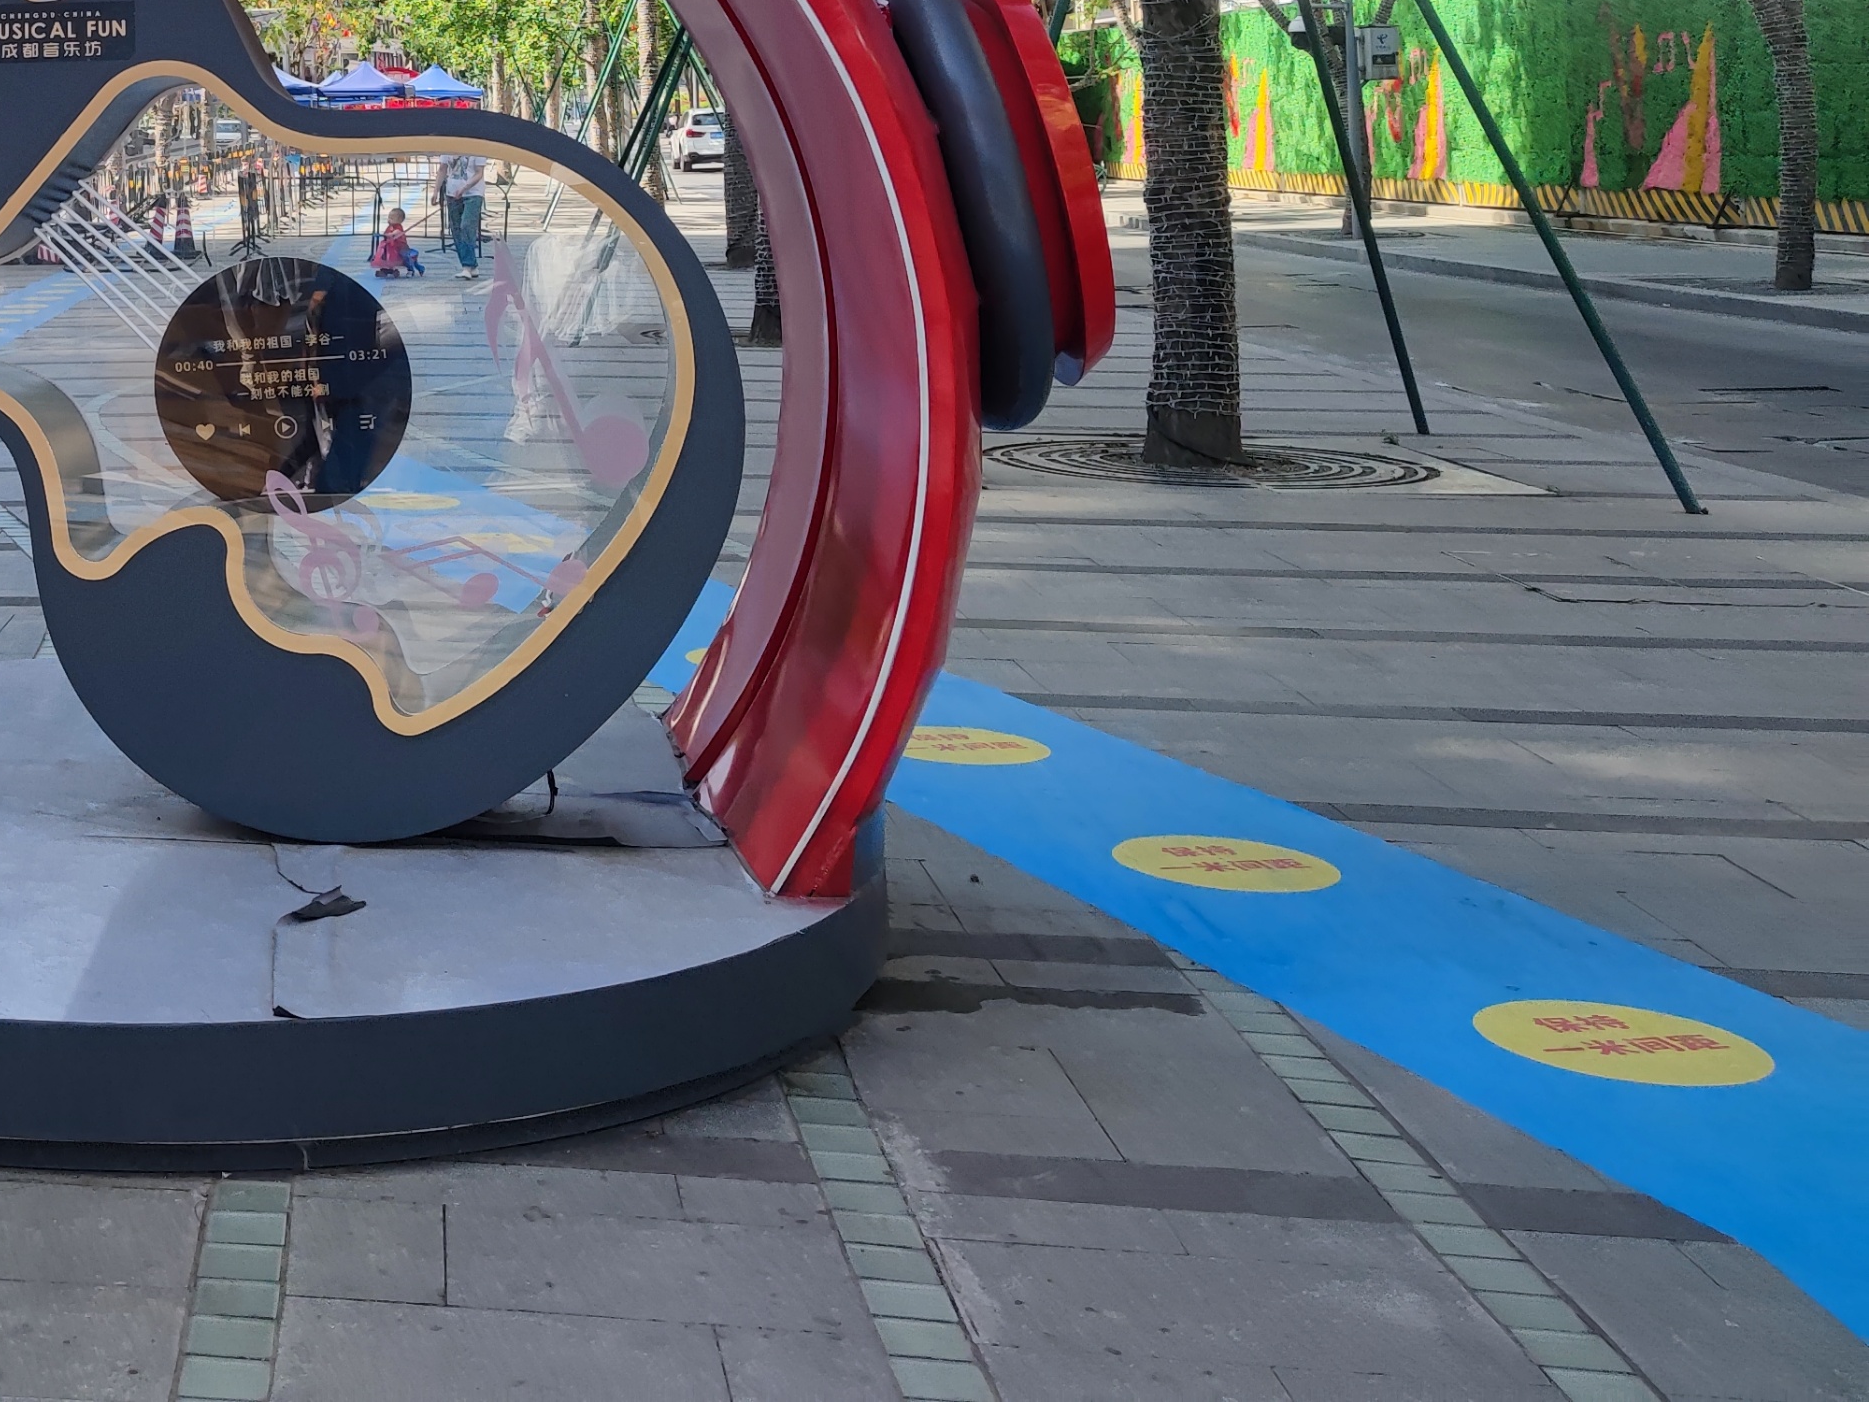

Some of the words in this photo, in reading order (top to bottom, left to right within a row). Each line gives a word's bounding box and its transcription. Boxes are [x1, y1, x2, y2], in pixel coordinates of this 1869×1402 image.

[86, 19, 127, 38] FUN
[1, 41, 102, 59] 成都音乐坊
[213, 335, 292, 353] 我和我的祖国
[349, 349, 388, 361] 03:21
[175, 360, 214, 373] 00:40
[240, 368, 320, 385] 我和我的祖国
[237, 383, 330, 401] 一刻也不能分割
[1532, 1014, 1630, 1033] 保持
[1543, 1034, 1730, 1055] 一米间距
